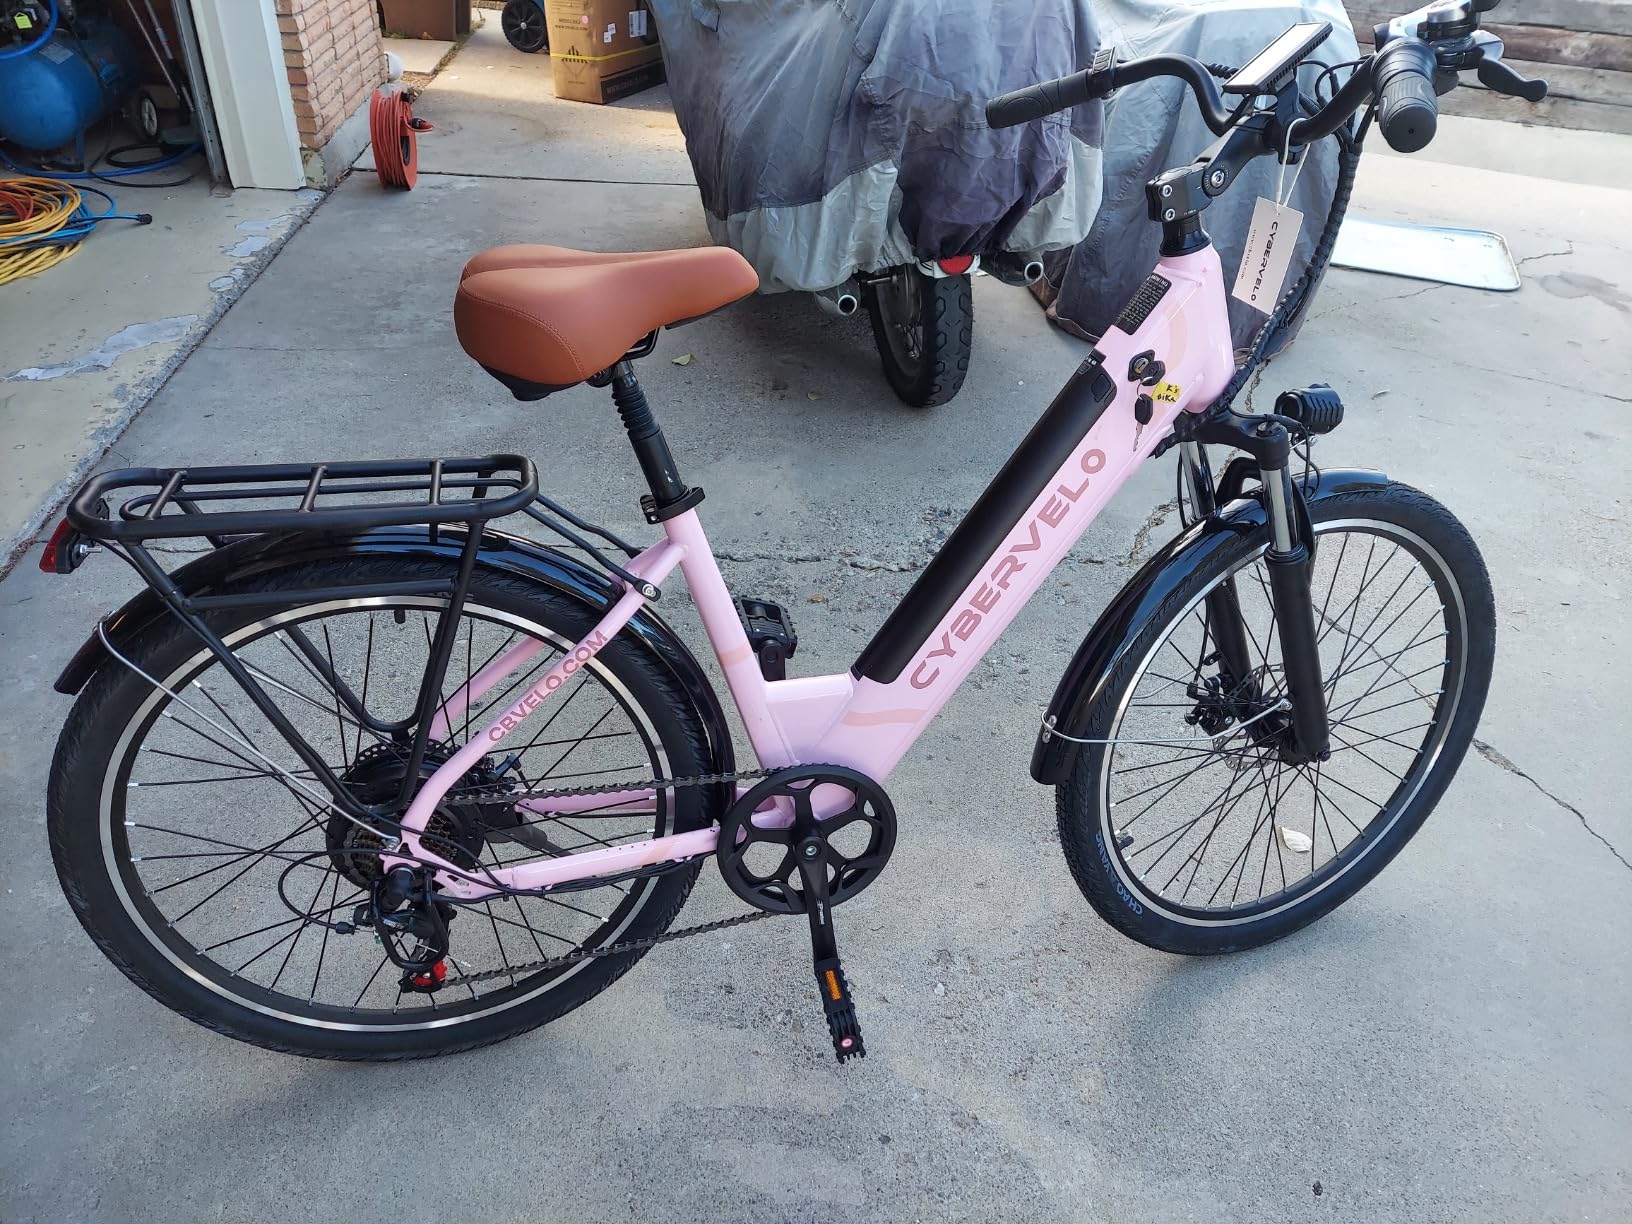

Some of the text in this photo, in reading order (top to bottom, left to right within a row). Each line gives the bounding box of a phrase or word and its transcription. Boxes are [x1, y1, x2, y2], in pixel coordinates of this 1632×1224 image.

[1251, 221, 1279, 301] CYBERVELO
[910, 448, 1107, 690] CYBERVELO
[488, 630, 608, 741] CBVELO.COM
[1117, 882, 1143, 915] CHAO
